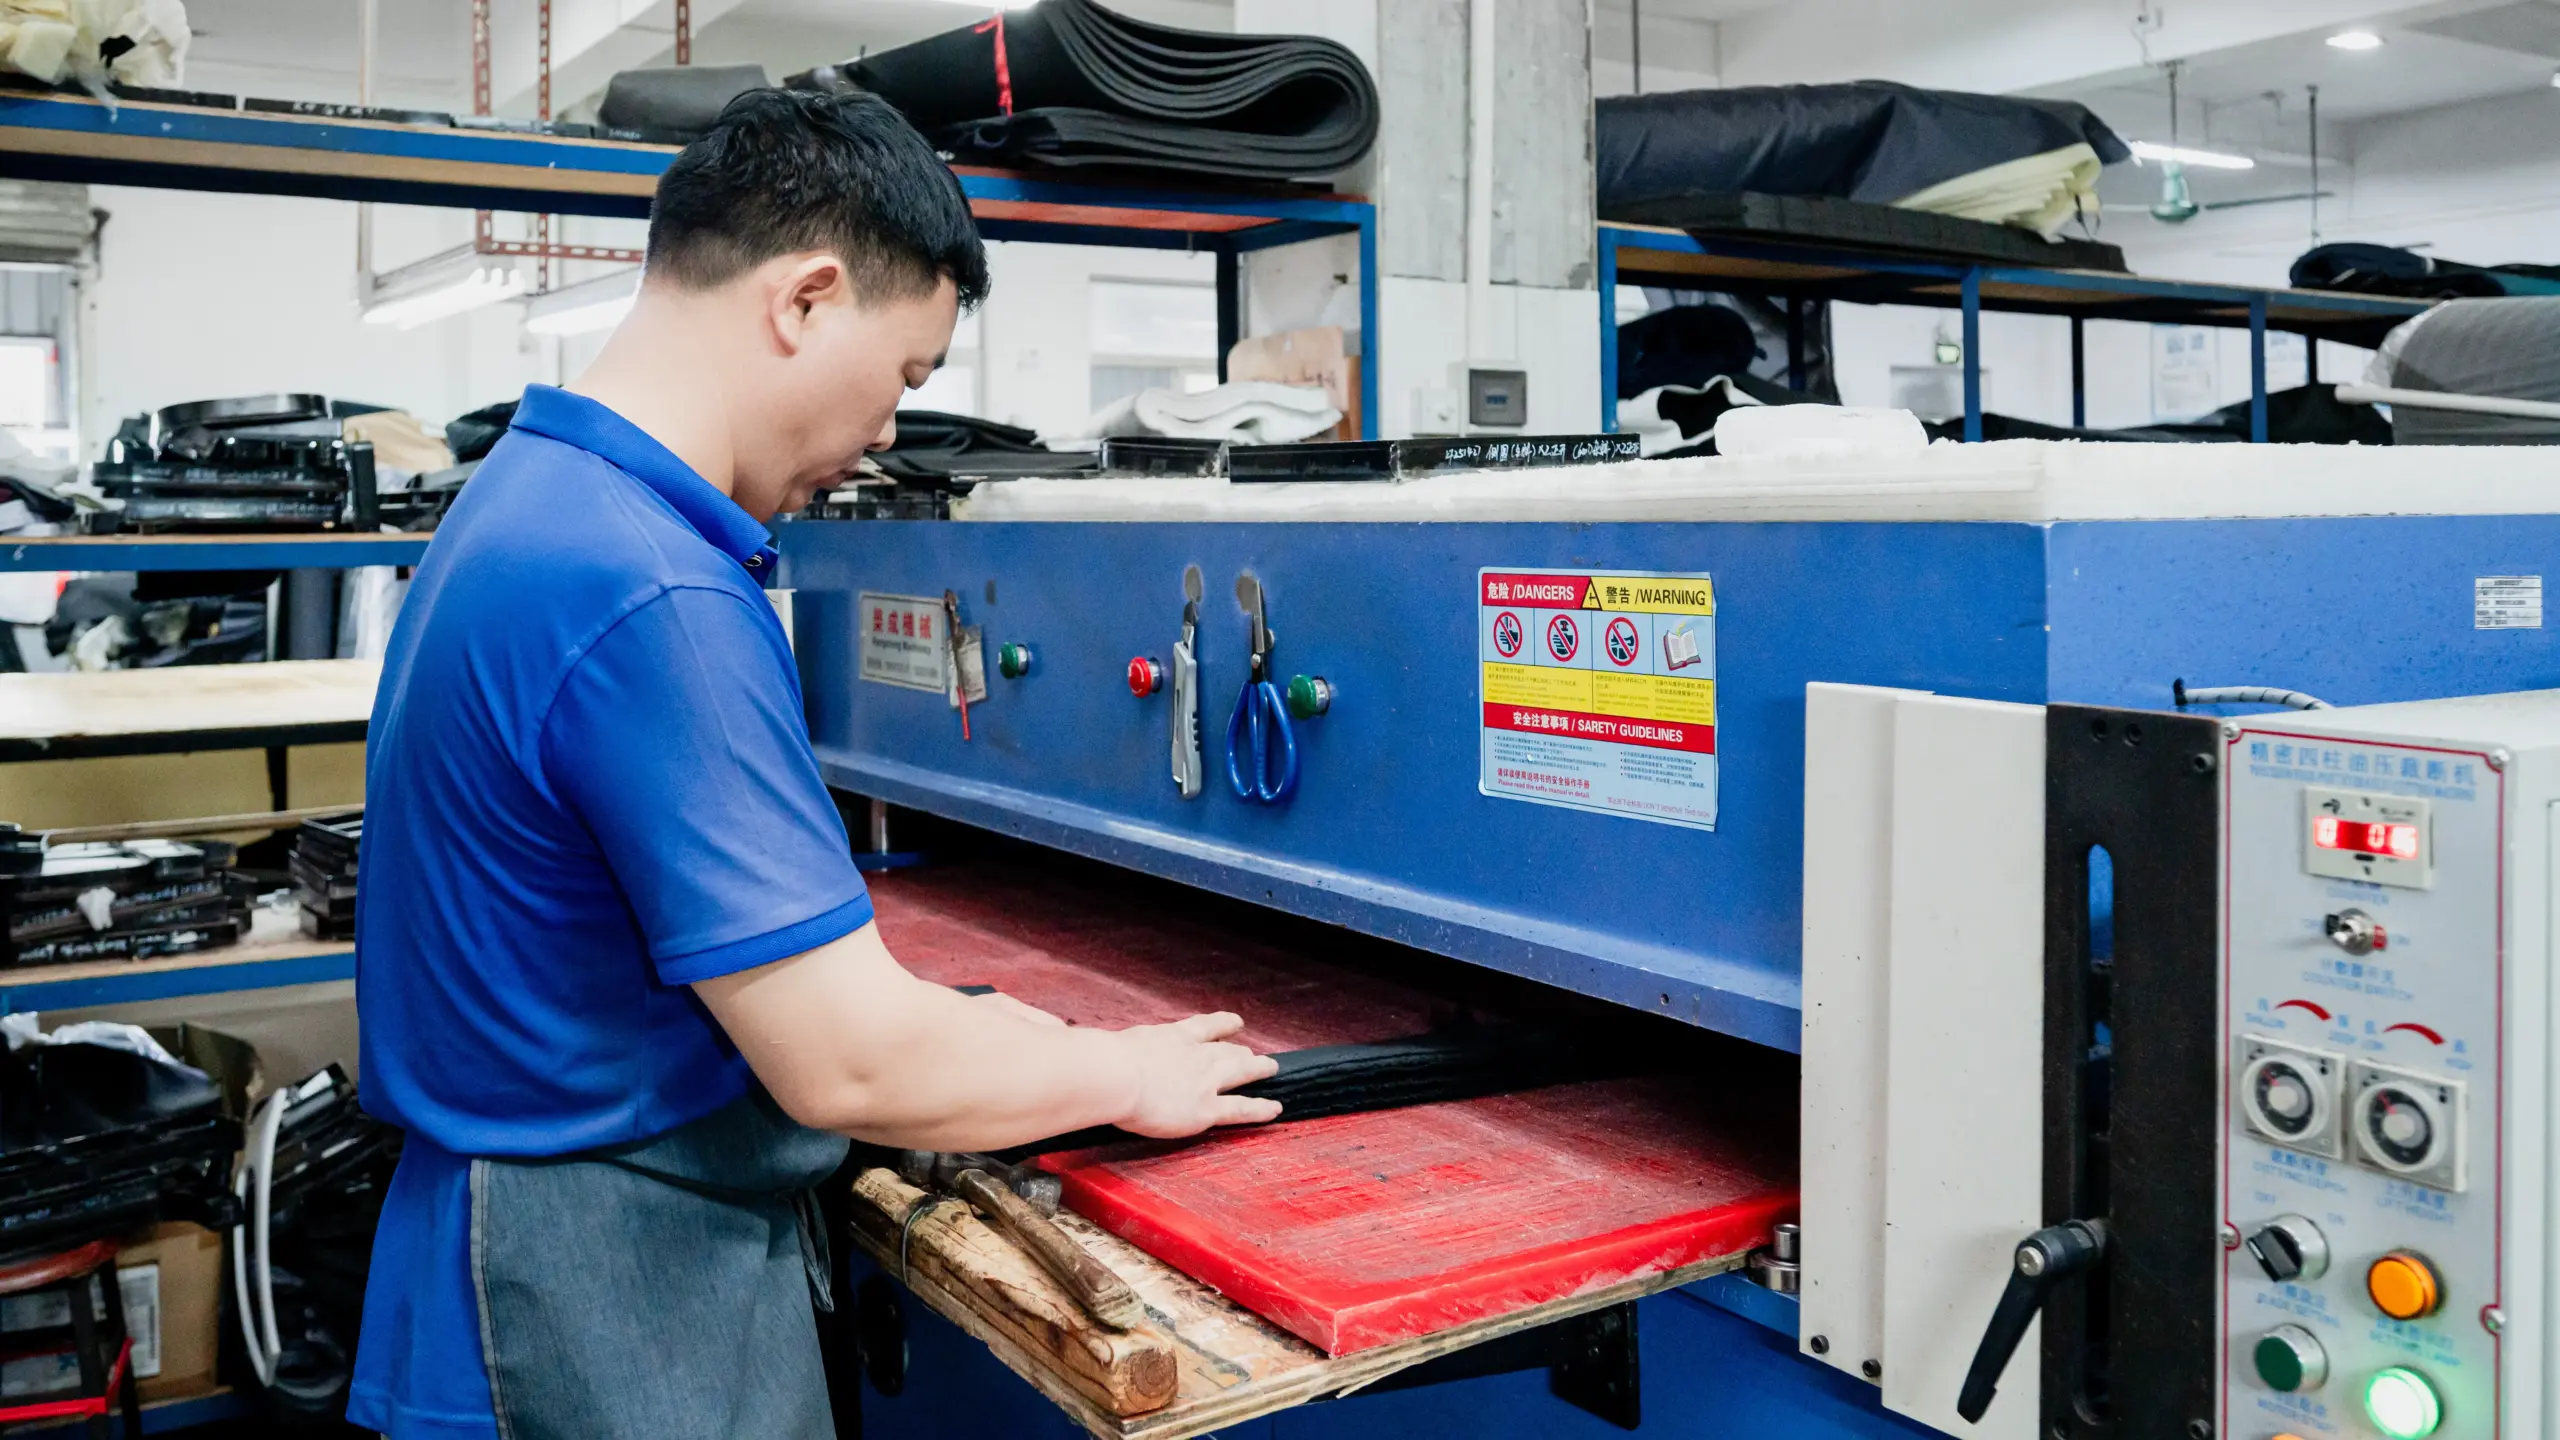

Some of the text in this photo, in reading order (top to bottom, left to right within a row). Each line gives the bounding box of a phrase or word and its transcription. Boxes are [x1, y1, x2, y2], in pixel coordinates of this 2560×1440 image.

[1487, 581, 1575, 601] 危险 /DANGERS
[1605, 586, 1706, 606] 警告 /WARNING
[1577, 719, 1618, 736] SARETY
[1619, 723, 1684, 743] GUIDELINES
